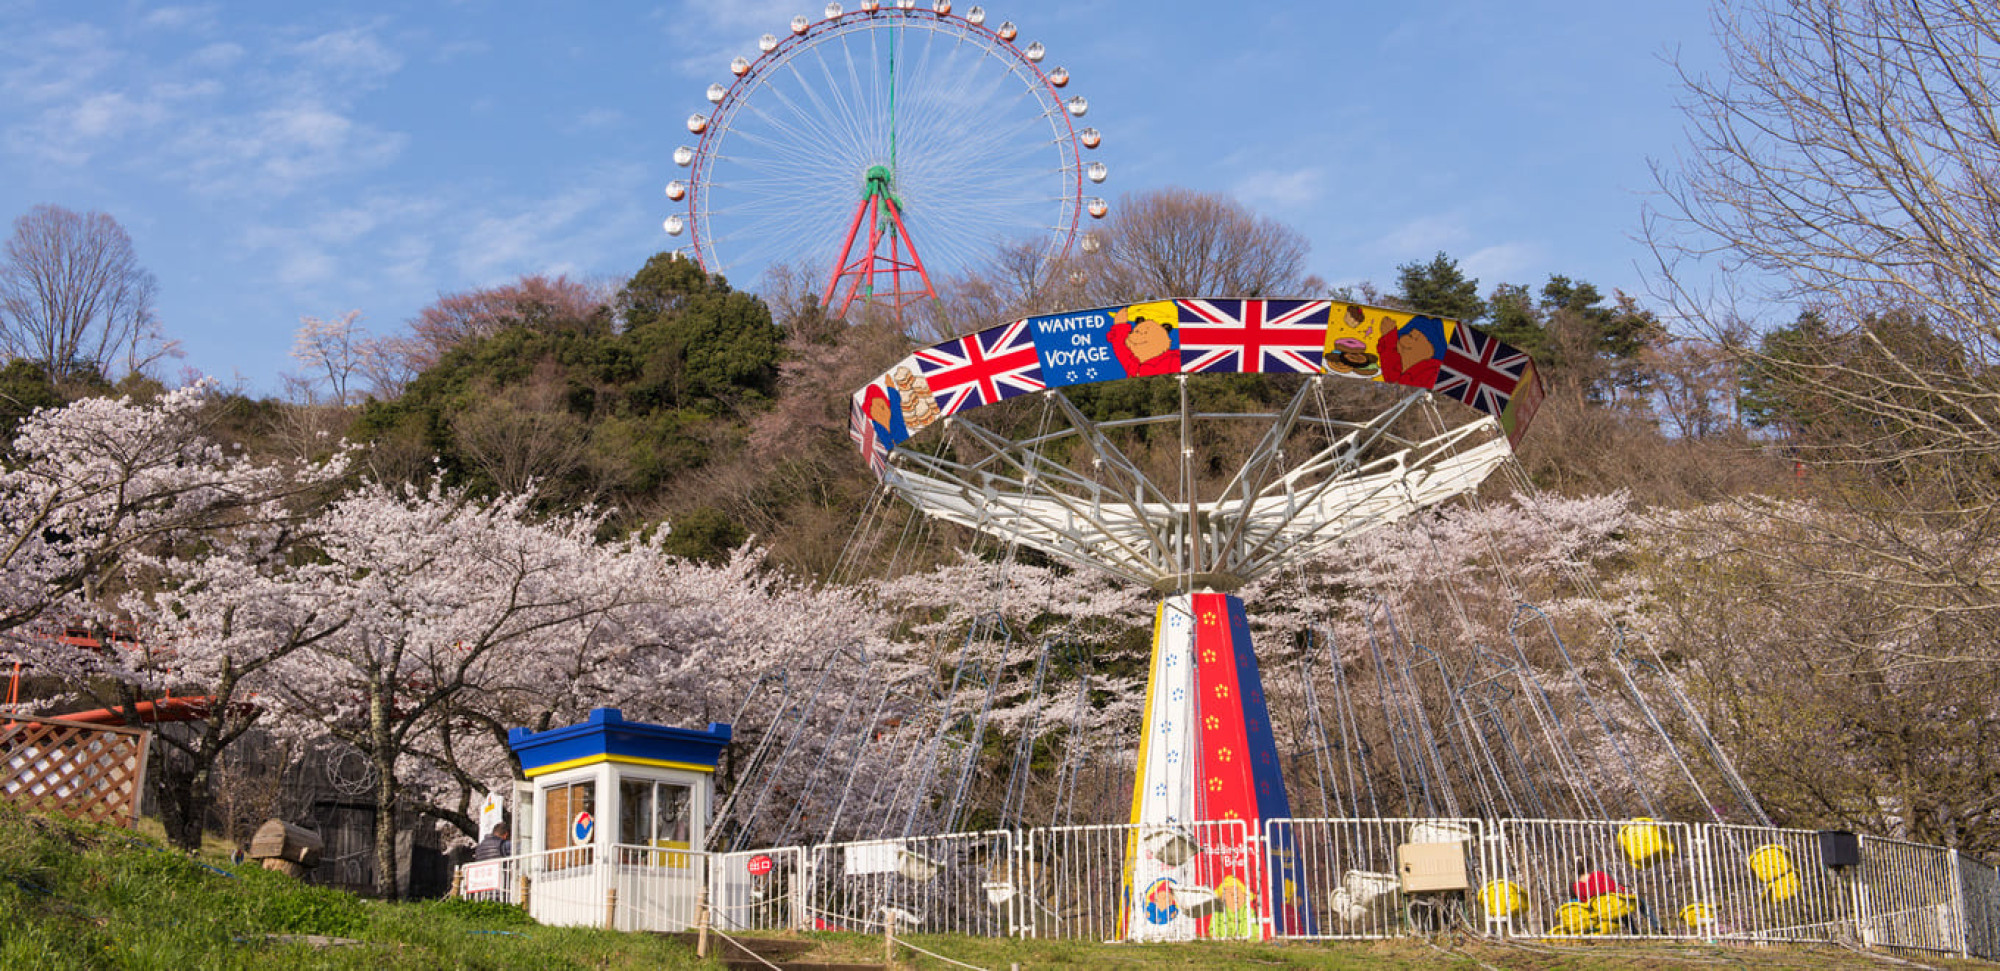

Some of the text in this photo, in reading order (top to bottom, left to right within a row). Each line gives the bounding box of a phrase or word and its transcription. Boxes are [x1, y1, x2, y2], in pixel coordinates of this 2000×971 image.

[1038, 315, 1105, 333] WANTED
[1071, 333, 1092, 346] ON
[1045, 346, 1110, 368] VOYAGE
[1203, 842, 1255, 858] Paddingtn
[749, 859, 770, 870] 出口
[1224, 855, 1248, 867] Bea
